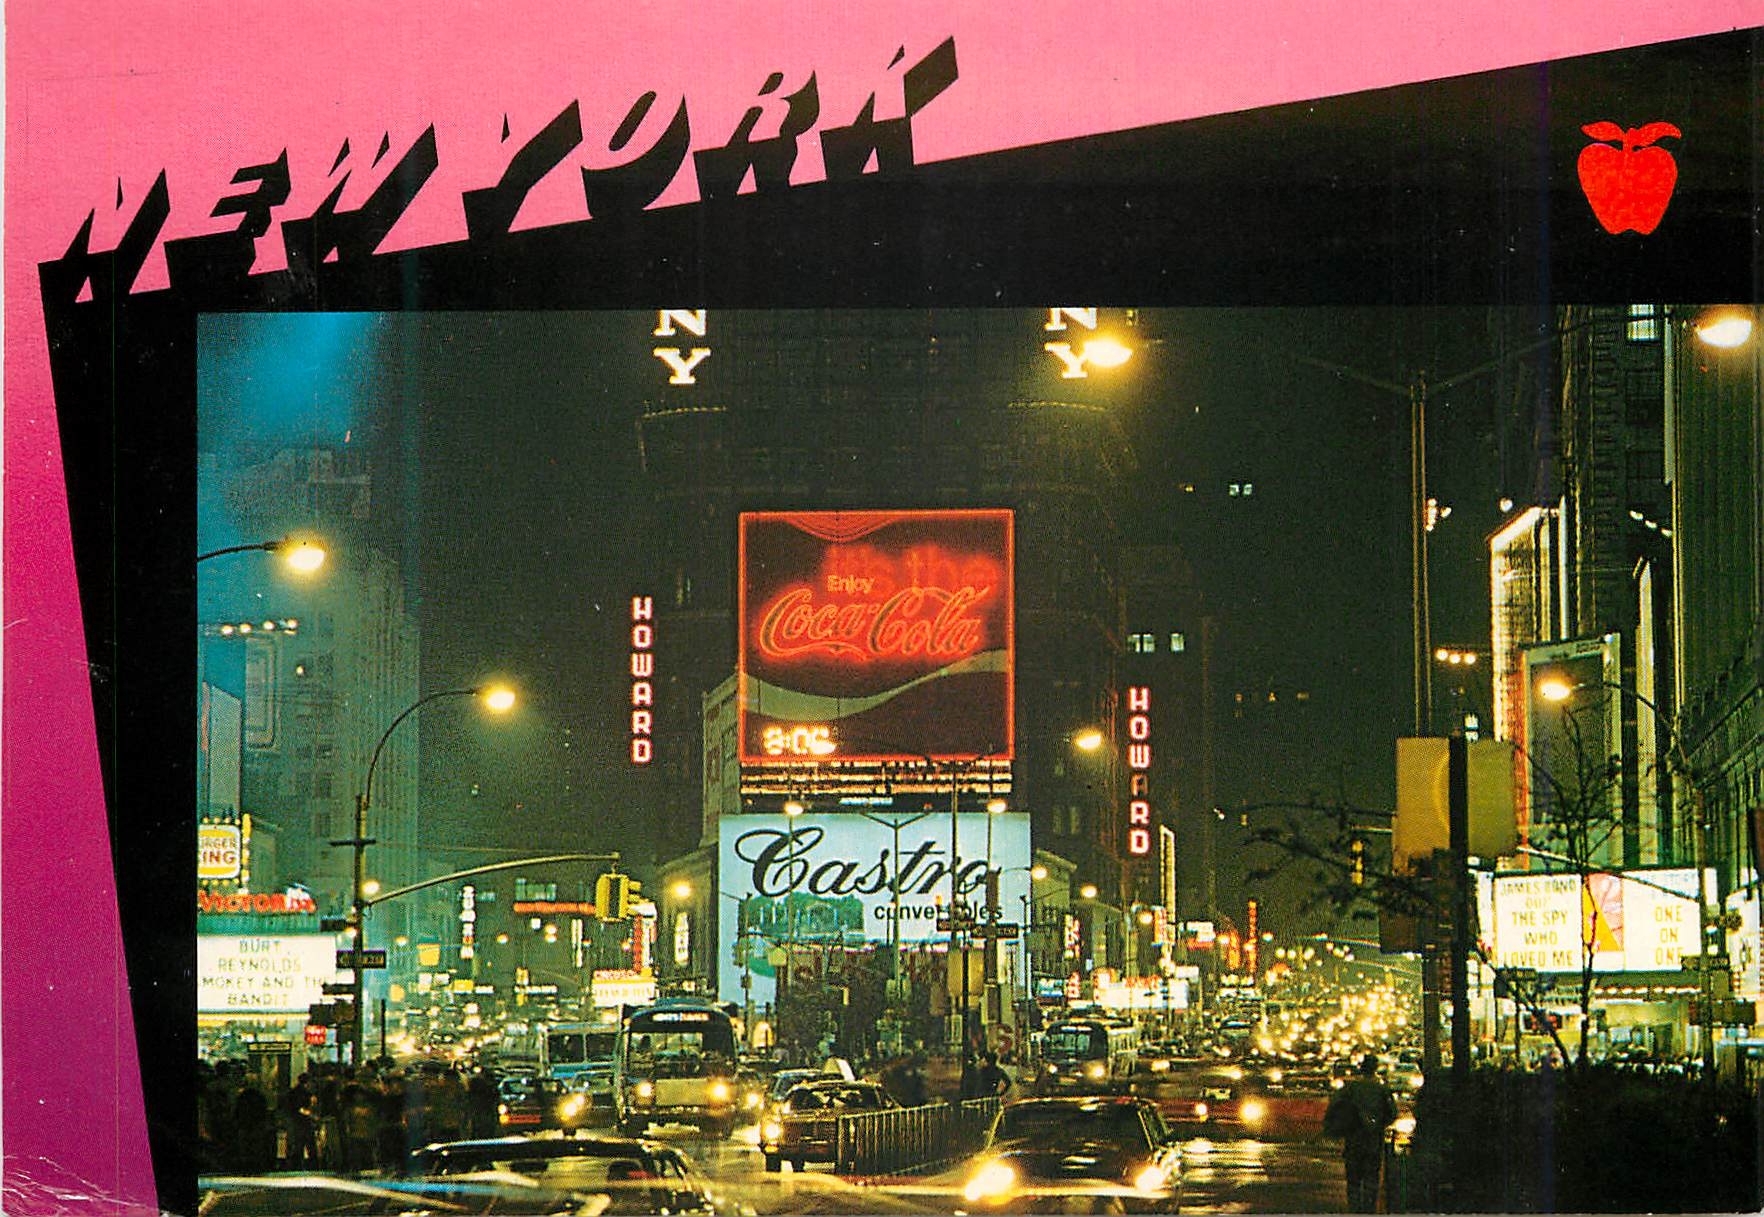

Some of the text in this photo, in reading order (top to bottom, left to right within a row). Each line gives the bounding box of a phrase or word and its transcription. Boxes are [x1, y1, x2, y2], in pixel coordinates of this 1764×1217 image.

[652, 309, 711, 384] NY
[826, 573, 874, 594] Enjoy
[631, 595, 654, 765] HOWARD
[1127, 685, 1151, 855] HOWARD
[734, 826, 1000, 896] Castro
[1511, 911, 1569, 927] THE SPY
[1655, 906, 1683, 922] ONE
[1524, 931, 1558, 945] WHO
[1660, 928, 1679, 943] ON
[239, 940, 282, 953] BURT
[218, 957, 301, 973] REYNOLDS
[1503, 950, 1575, 967] LOVED ME
[262, 976, 295, 990] AND
[227, 992, 289, 1006] BANDIT
